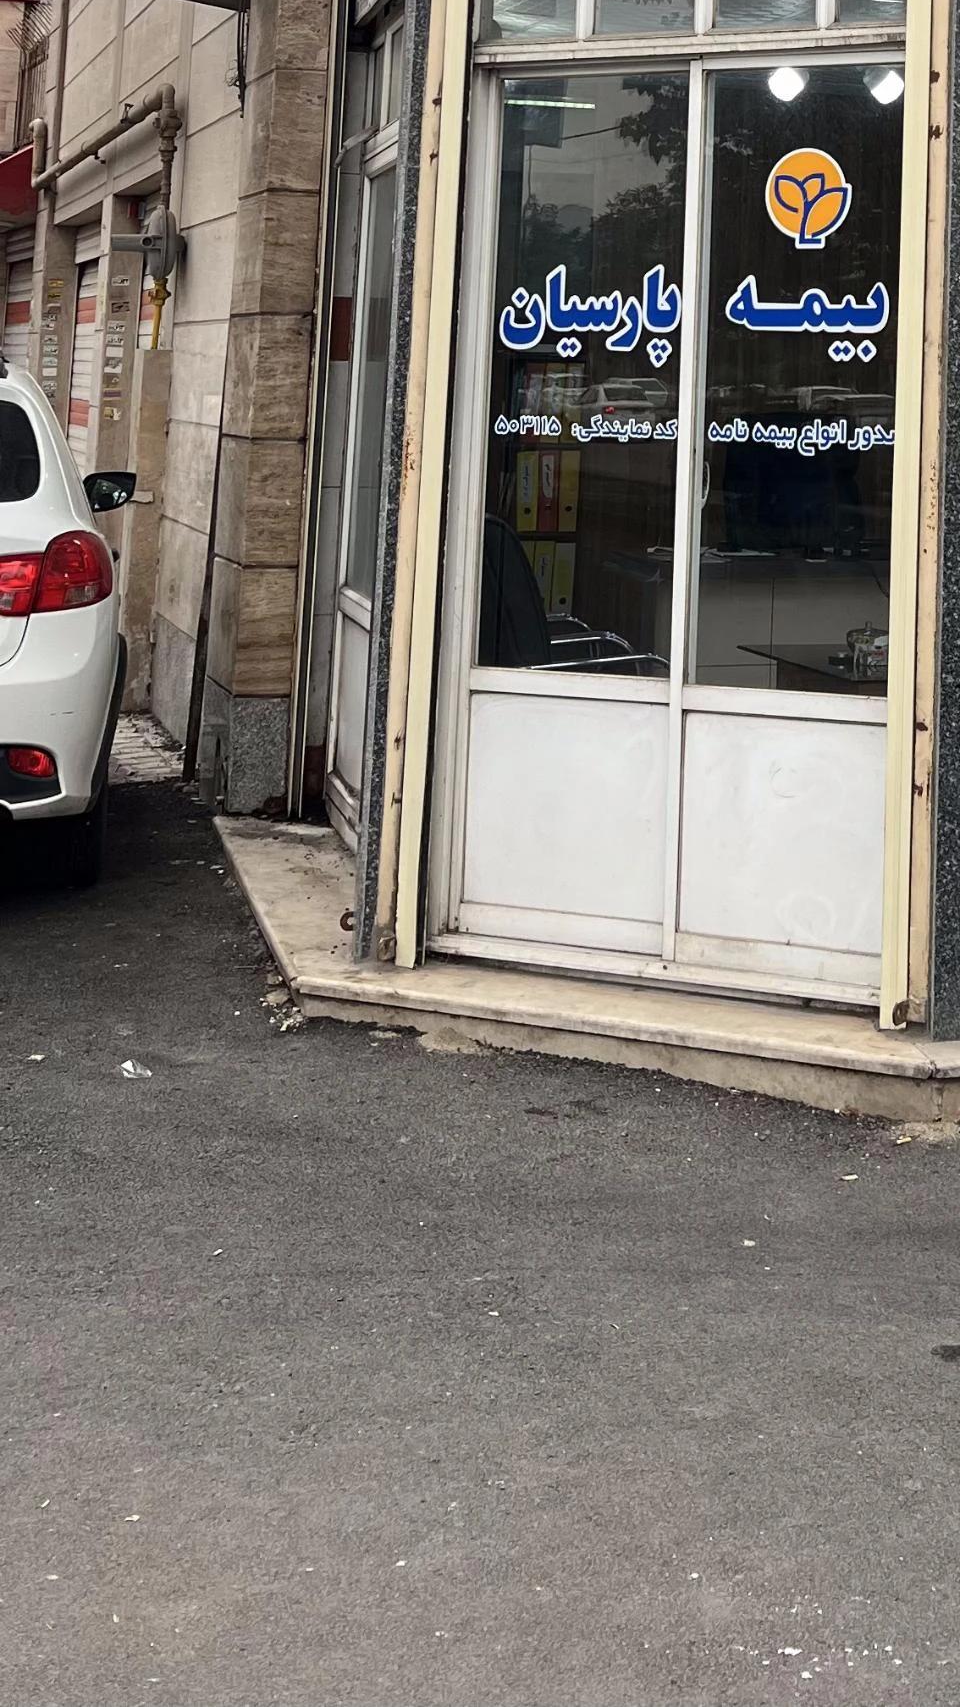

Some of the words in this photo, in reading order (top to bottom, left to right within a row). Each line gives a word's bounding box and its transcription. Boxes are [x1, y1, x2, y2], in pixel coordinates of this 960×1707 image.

[499, 263, 683, 368] پارسیان
[725, 274, 890, 363] بیمه
[494, 414, 562, 436] ۵۰۳۱۱۵
[653, 419, 678, 441] کد
[708, 418, 751, 441] نامه
[752, 422, 796, 448] بیمه
[797, 419, 847, 456] انواع
